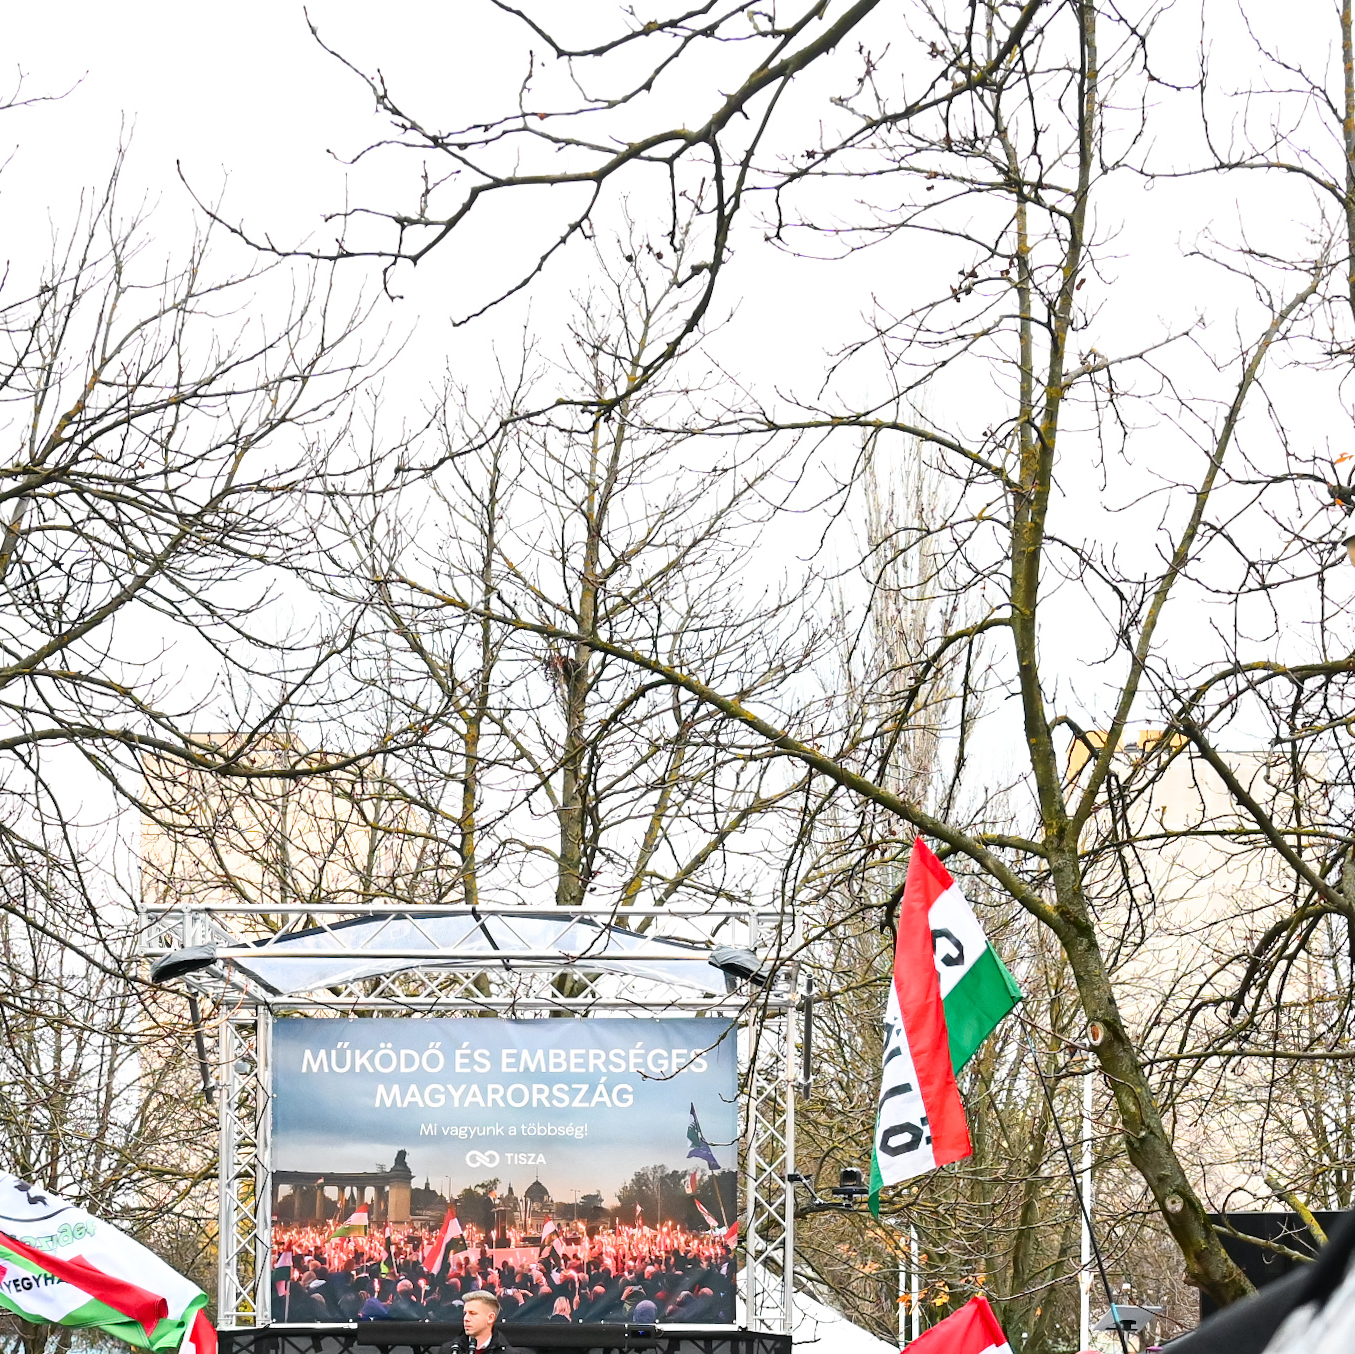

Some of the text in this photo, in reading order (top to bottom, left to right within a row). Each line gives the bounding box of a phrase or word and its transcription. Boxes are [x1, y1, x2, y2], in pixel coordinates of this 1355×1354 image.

[301, 1041, 709, 1074] MŰKÖDŐ ÉS EMBERSÉGES
[374, 1077, 635, 1109] MAGYARORSZÁG
[419, 1122, 589, 1139] Mi vagyunk a többség!
[504, 1152, 547, 1165] TISZA
